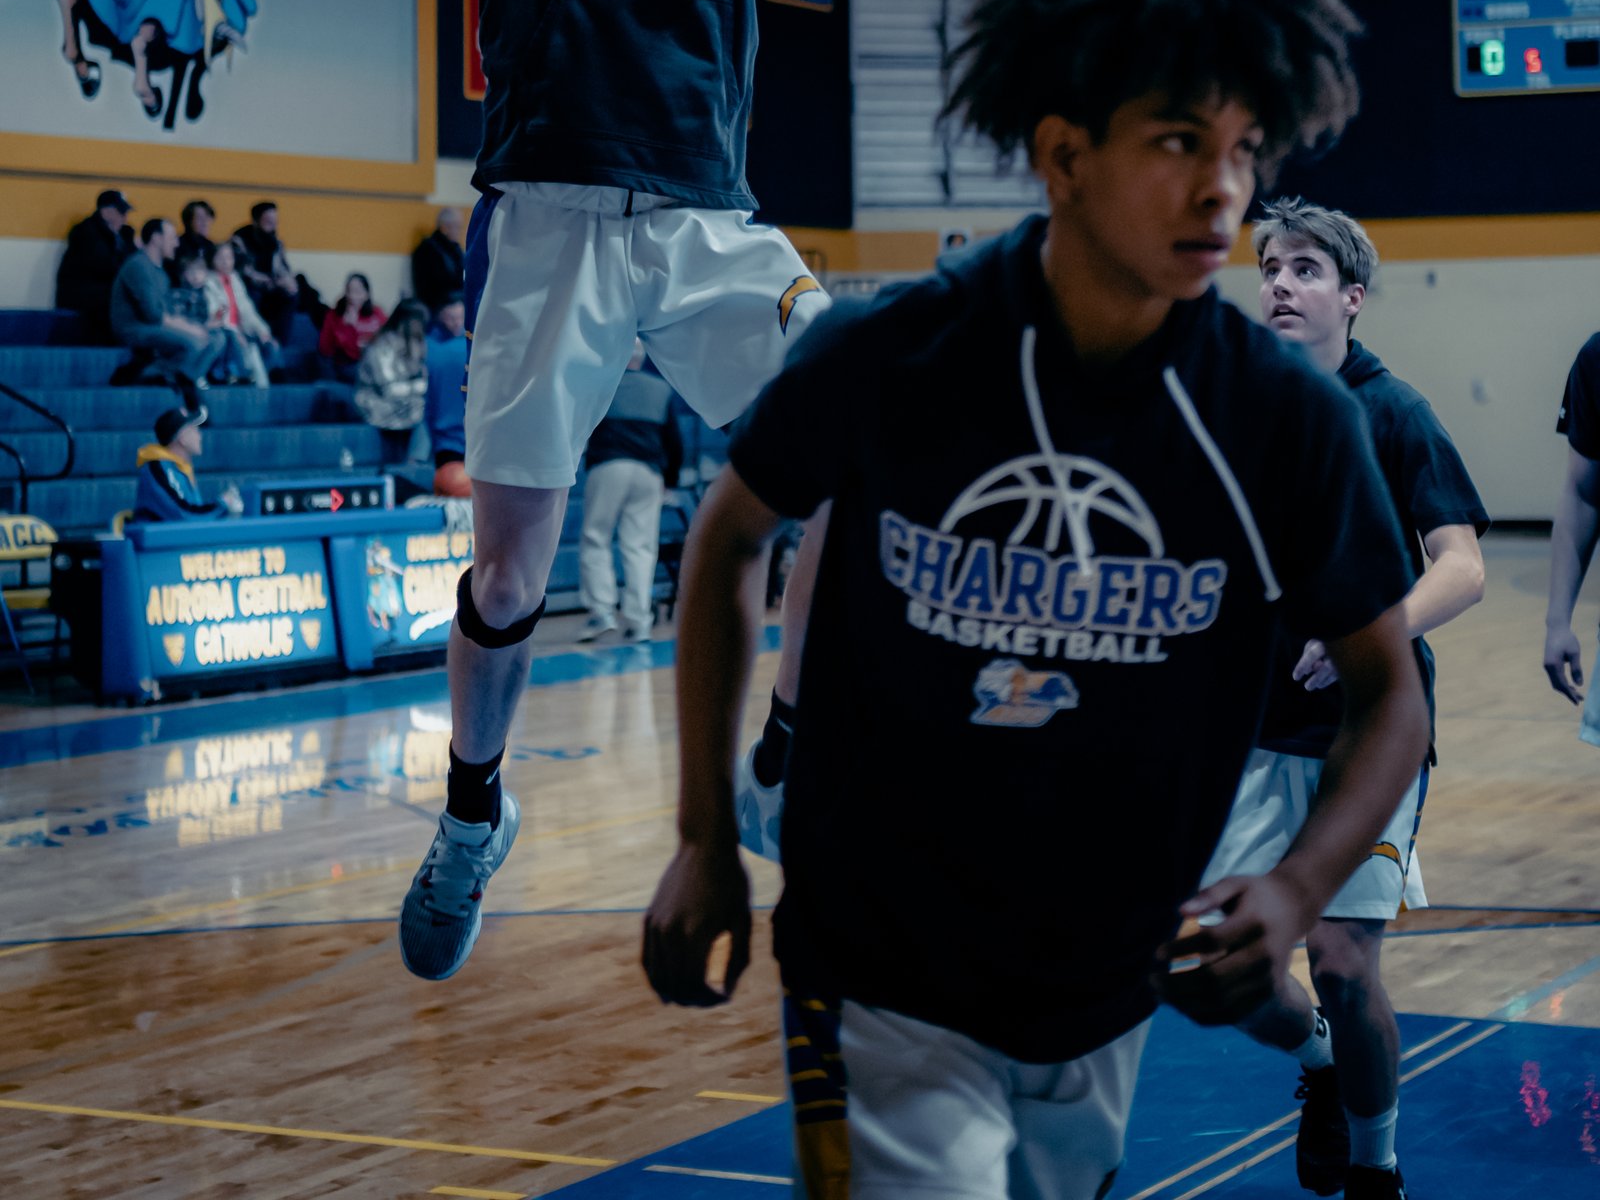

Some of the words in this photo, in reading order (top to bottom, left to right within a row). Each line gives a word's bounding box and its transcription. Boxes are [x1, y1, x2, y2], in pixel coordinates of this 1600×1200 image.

[1480, 39, 1505, 76] 0
[879, 509, 1229, 637] CHARGERS
[195, 617, 294, 666] CATHOLIC
[906, 599, 1169, 664] BASKETBALL
